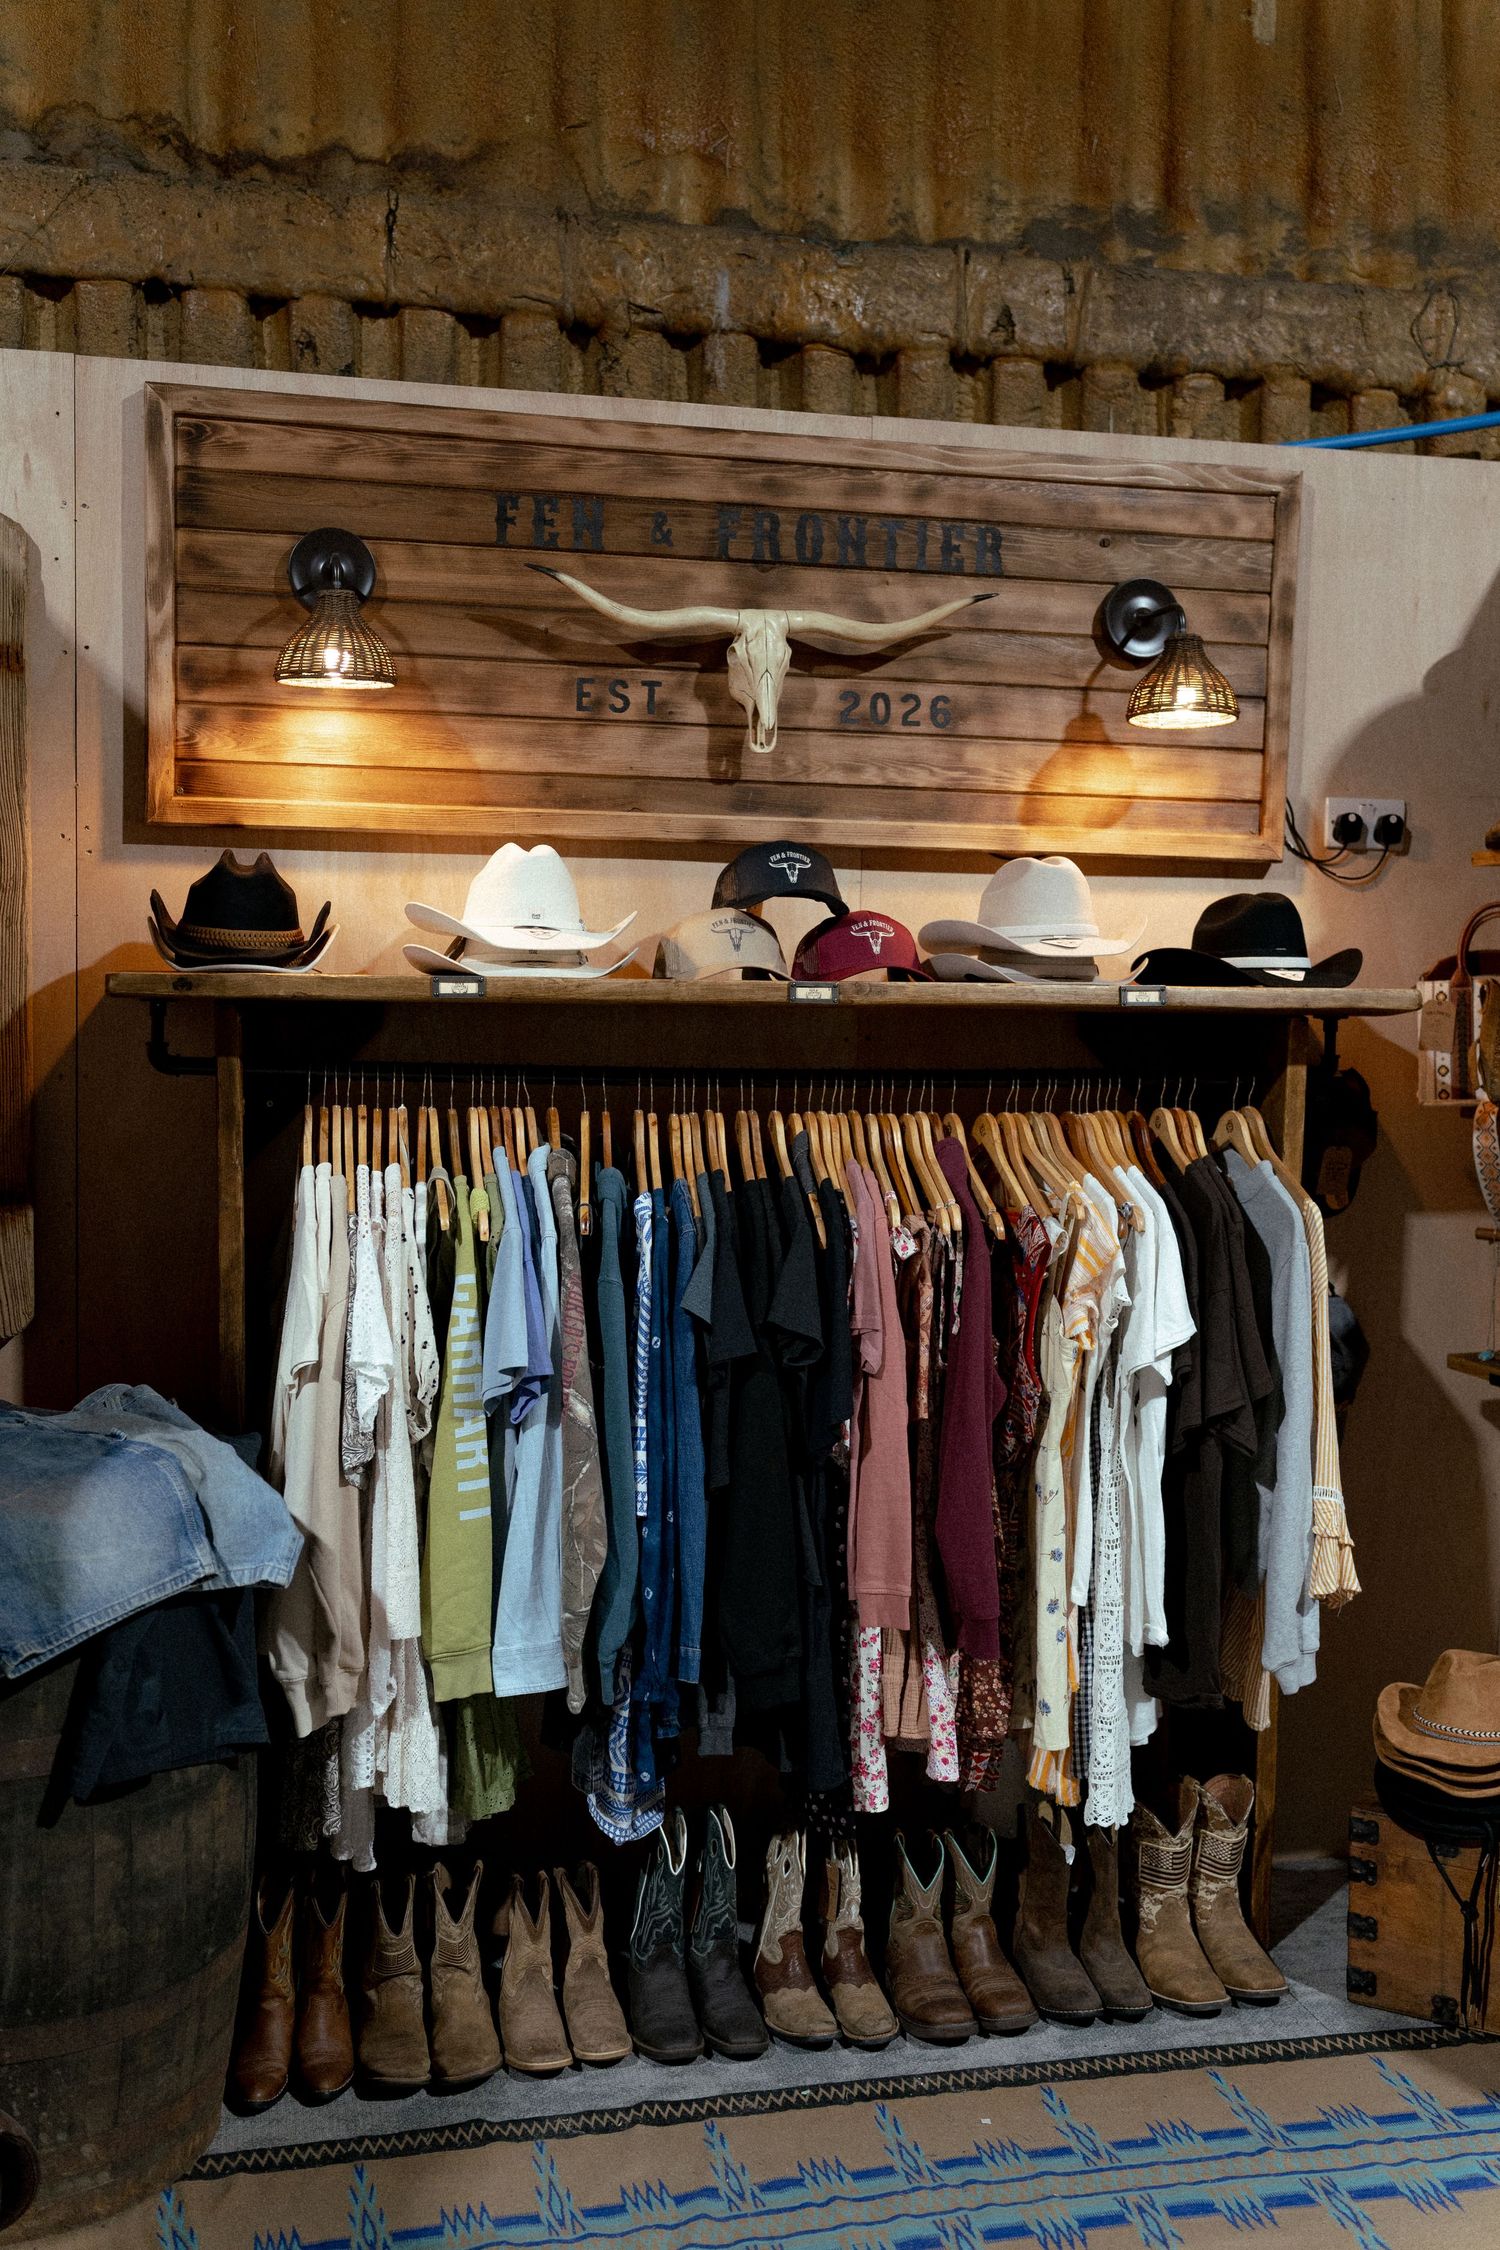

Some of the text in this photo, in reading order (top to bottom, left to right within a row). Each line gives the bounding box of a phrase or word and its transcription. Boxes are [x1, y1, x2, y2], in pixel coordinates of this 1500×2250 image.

[495, 493, 1003, 574] FEN & FRONTIER
[575, 677, 952, 729] EST 2026
